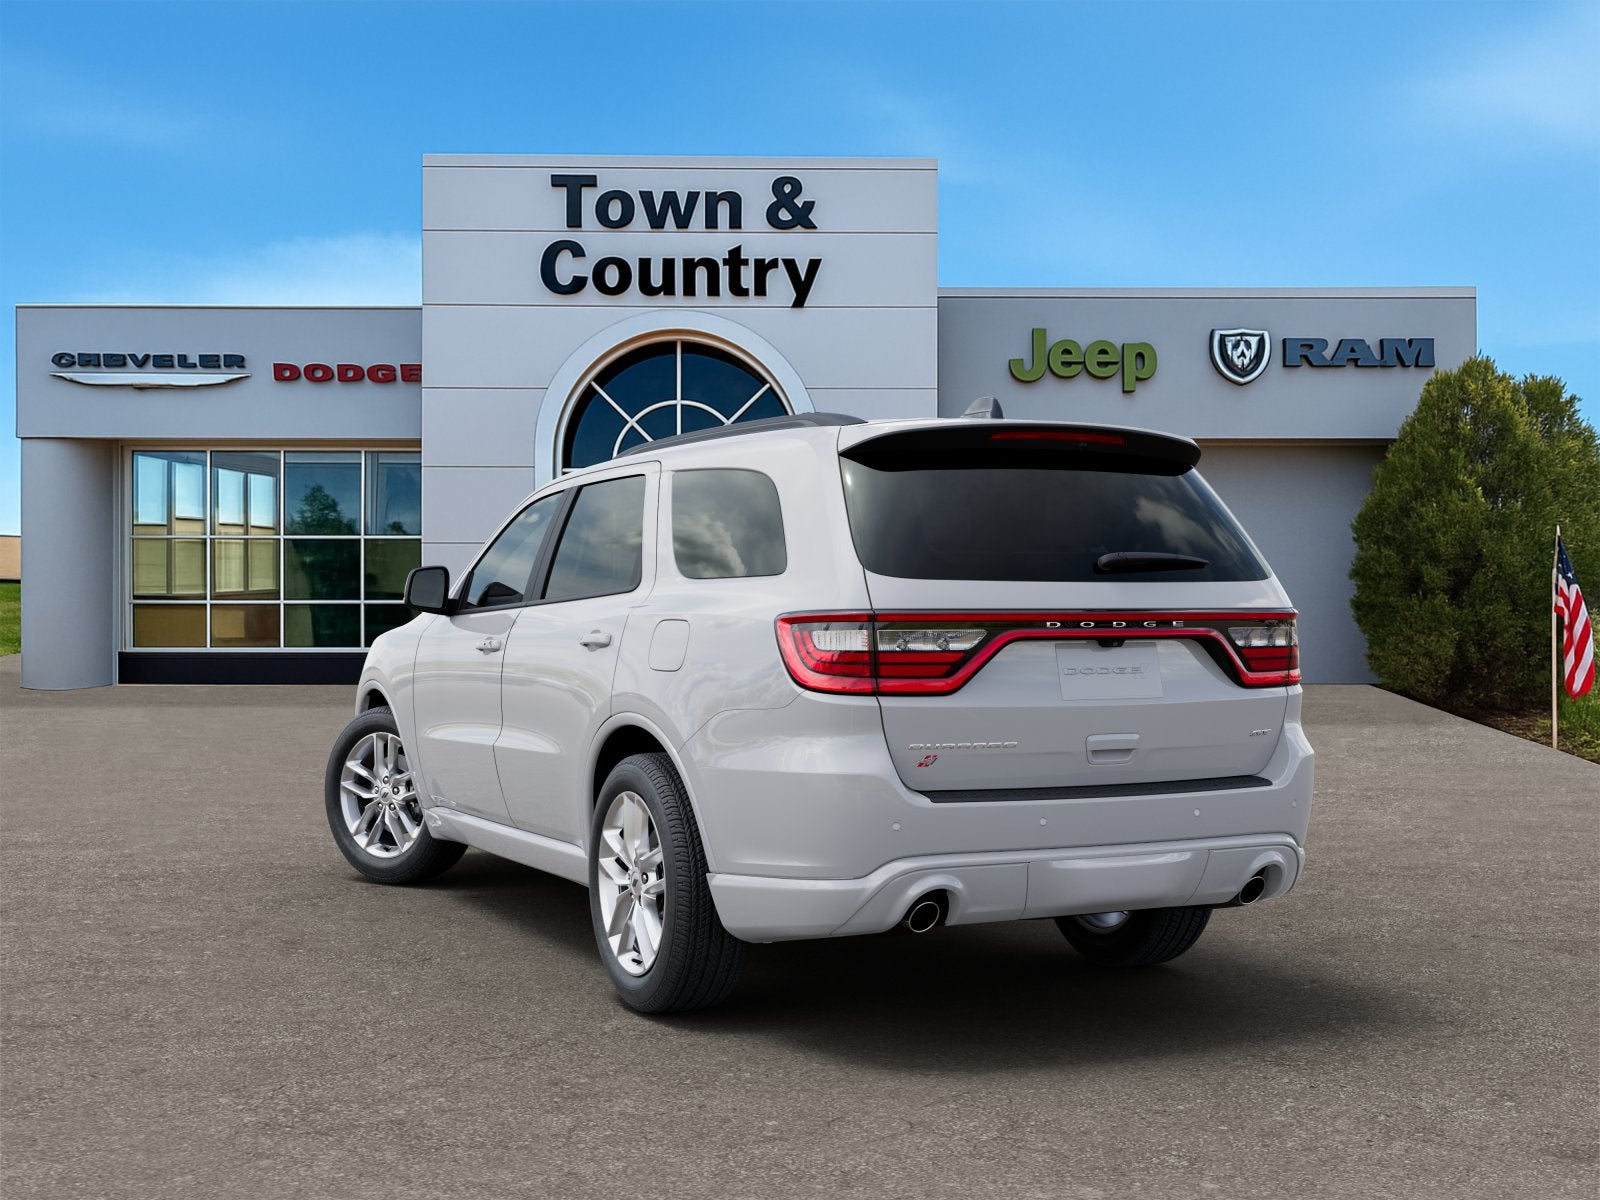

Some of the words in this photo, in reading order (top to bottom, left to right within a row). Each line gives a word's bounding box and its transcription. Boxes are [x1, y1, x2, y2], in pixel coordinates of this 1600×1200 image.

[551, 174, 743, 230] Town
[766, 176, 818, 230] &
[540, 239, 822, 309] Country
[1009, 328, 1157, 393] Jeep
[1282, 337, 1436, 368] RAM
[272, 362, 422, 384] DODGE
[1046, 620, 1185, 629] DODGE
[1063, 666, 1145, 676] DODGE
